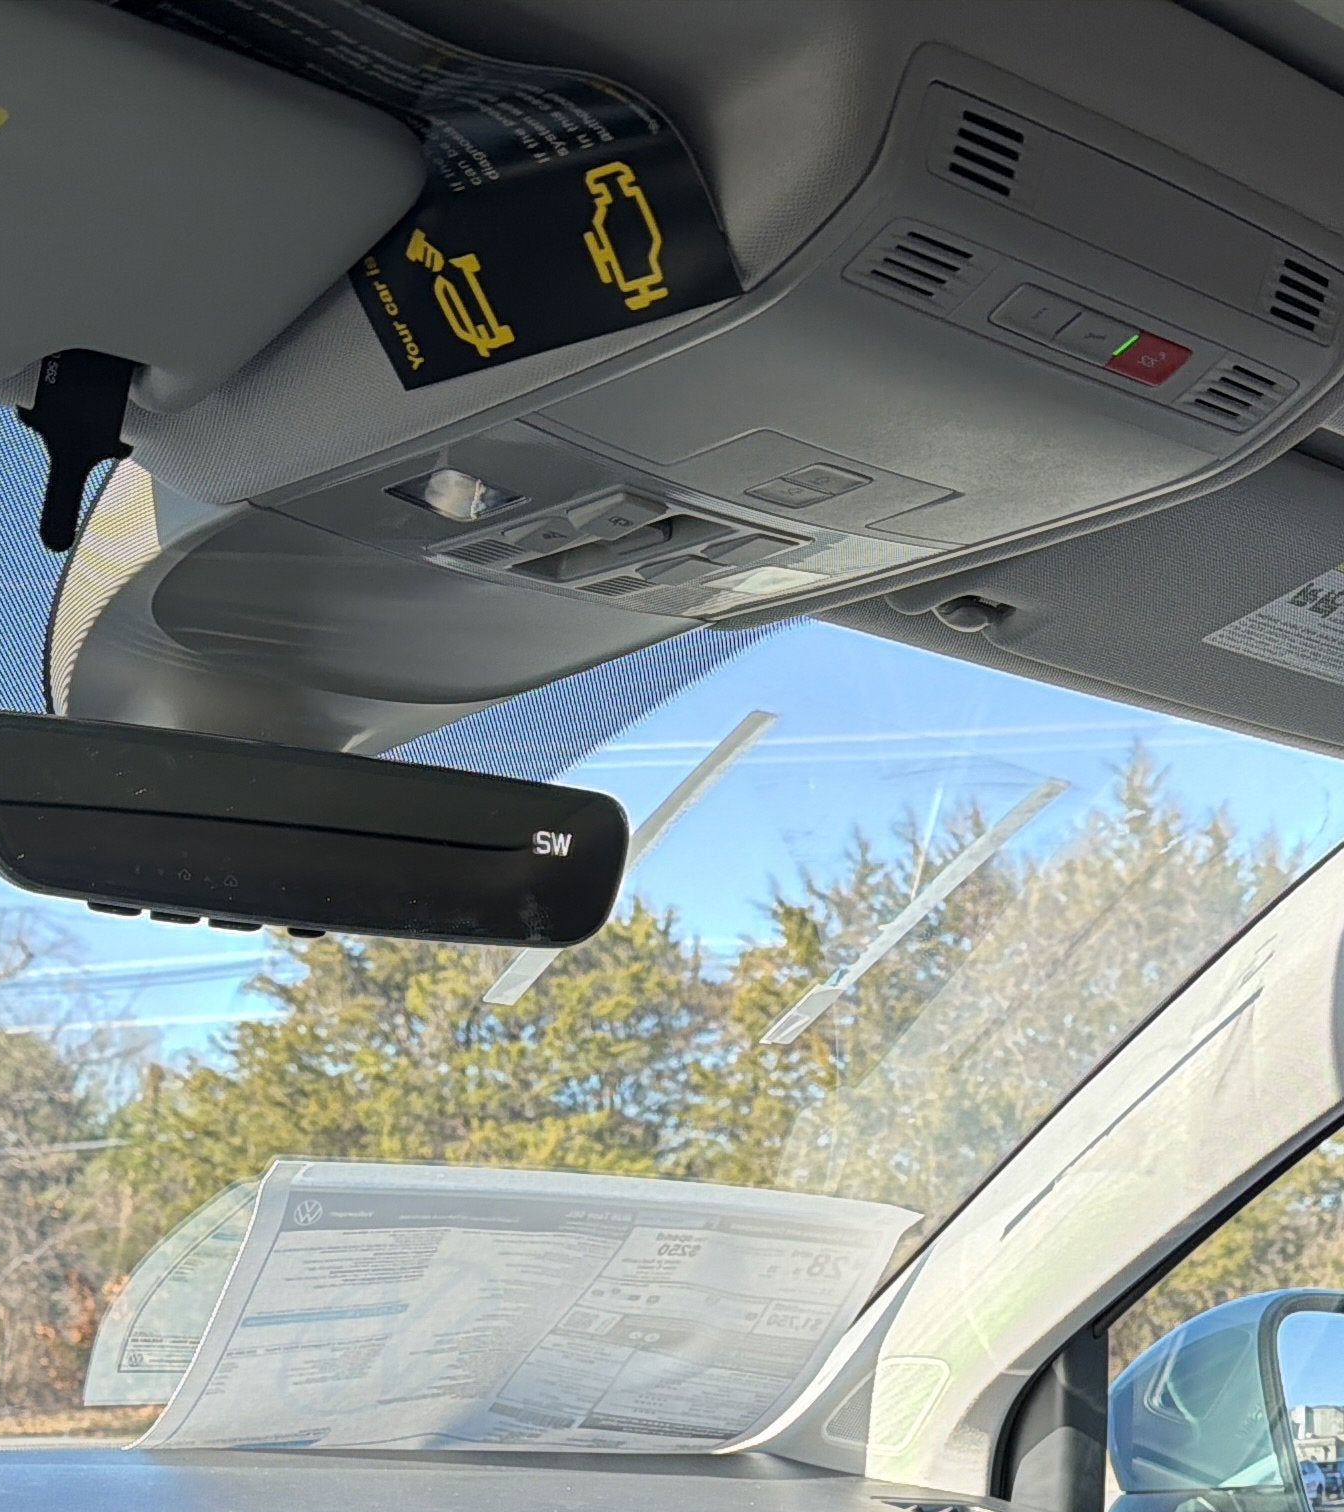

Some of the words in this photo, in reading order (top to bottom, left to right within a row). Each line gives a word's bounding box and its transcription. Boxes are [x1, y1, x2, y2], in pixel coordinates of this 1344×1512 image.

[457, 160, 482, 186] can
[363, 255, 380, 277] is
[374, 280, 400, 317] car
[392, 318, 425, 370] Your
[532, 830, 572, 858] SW
